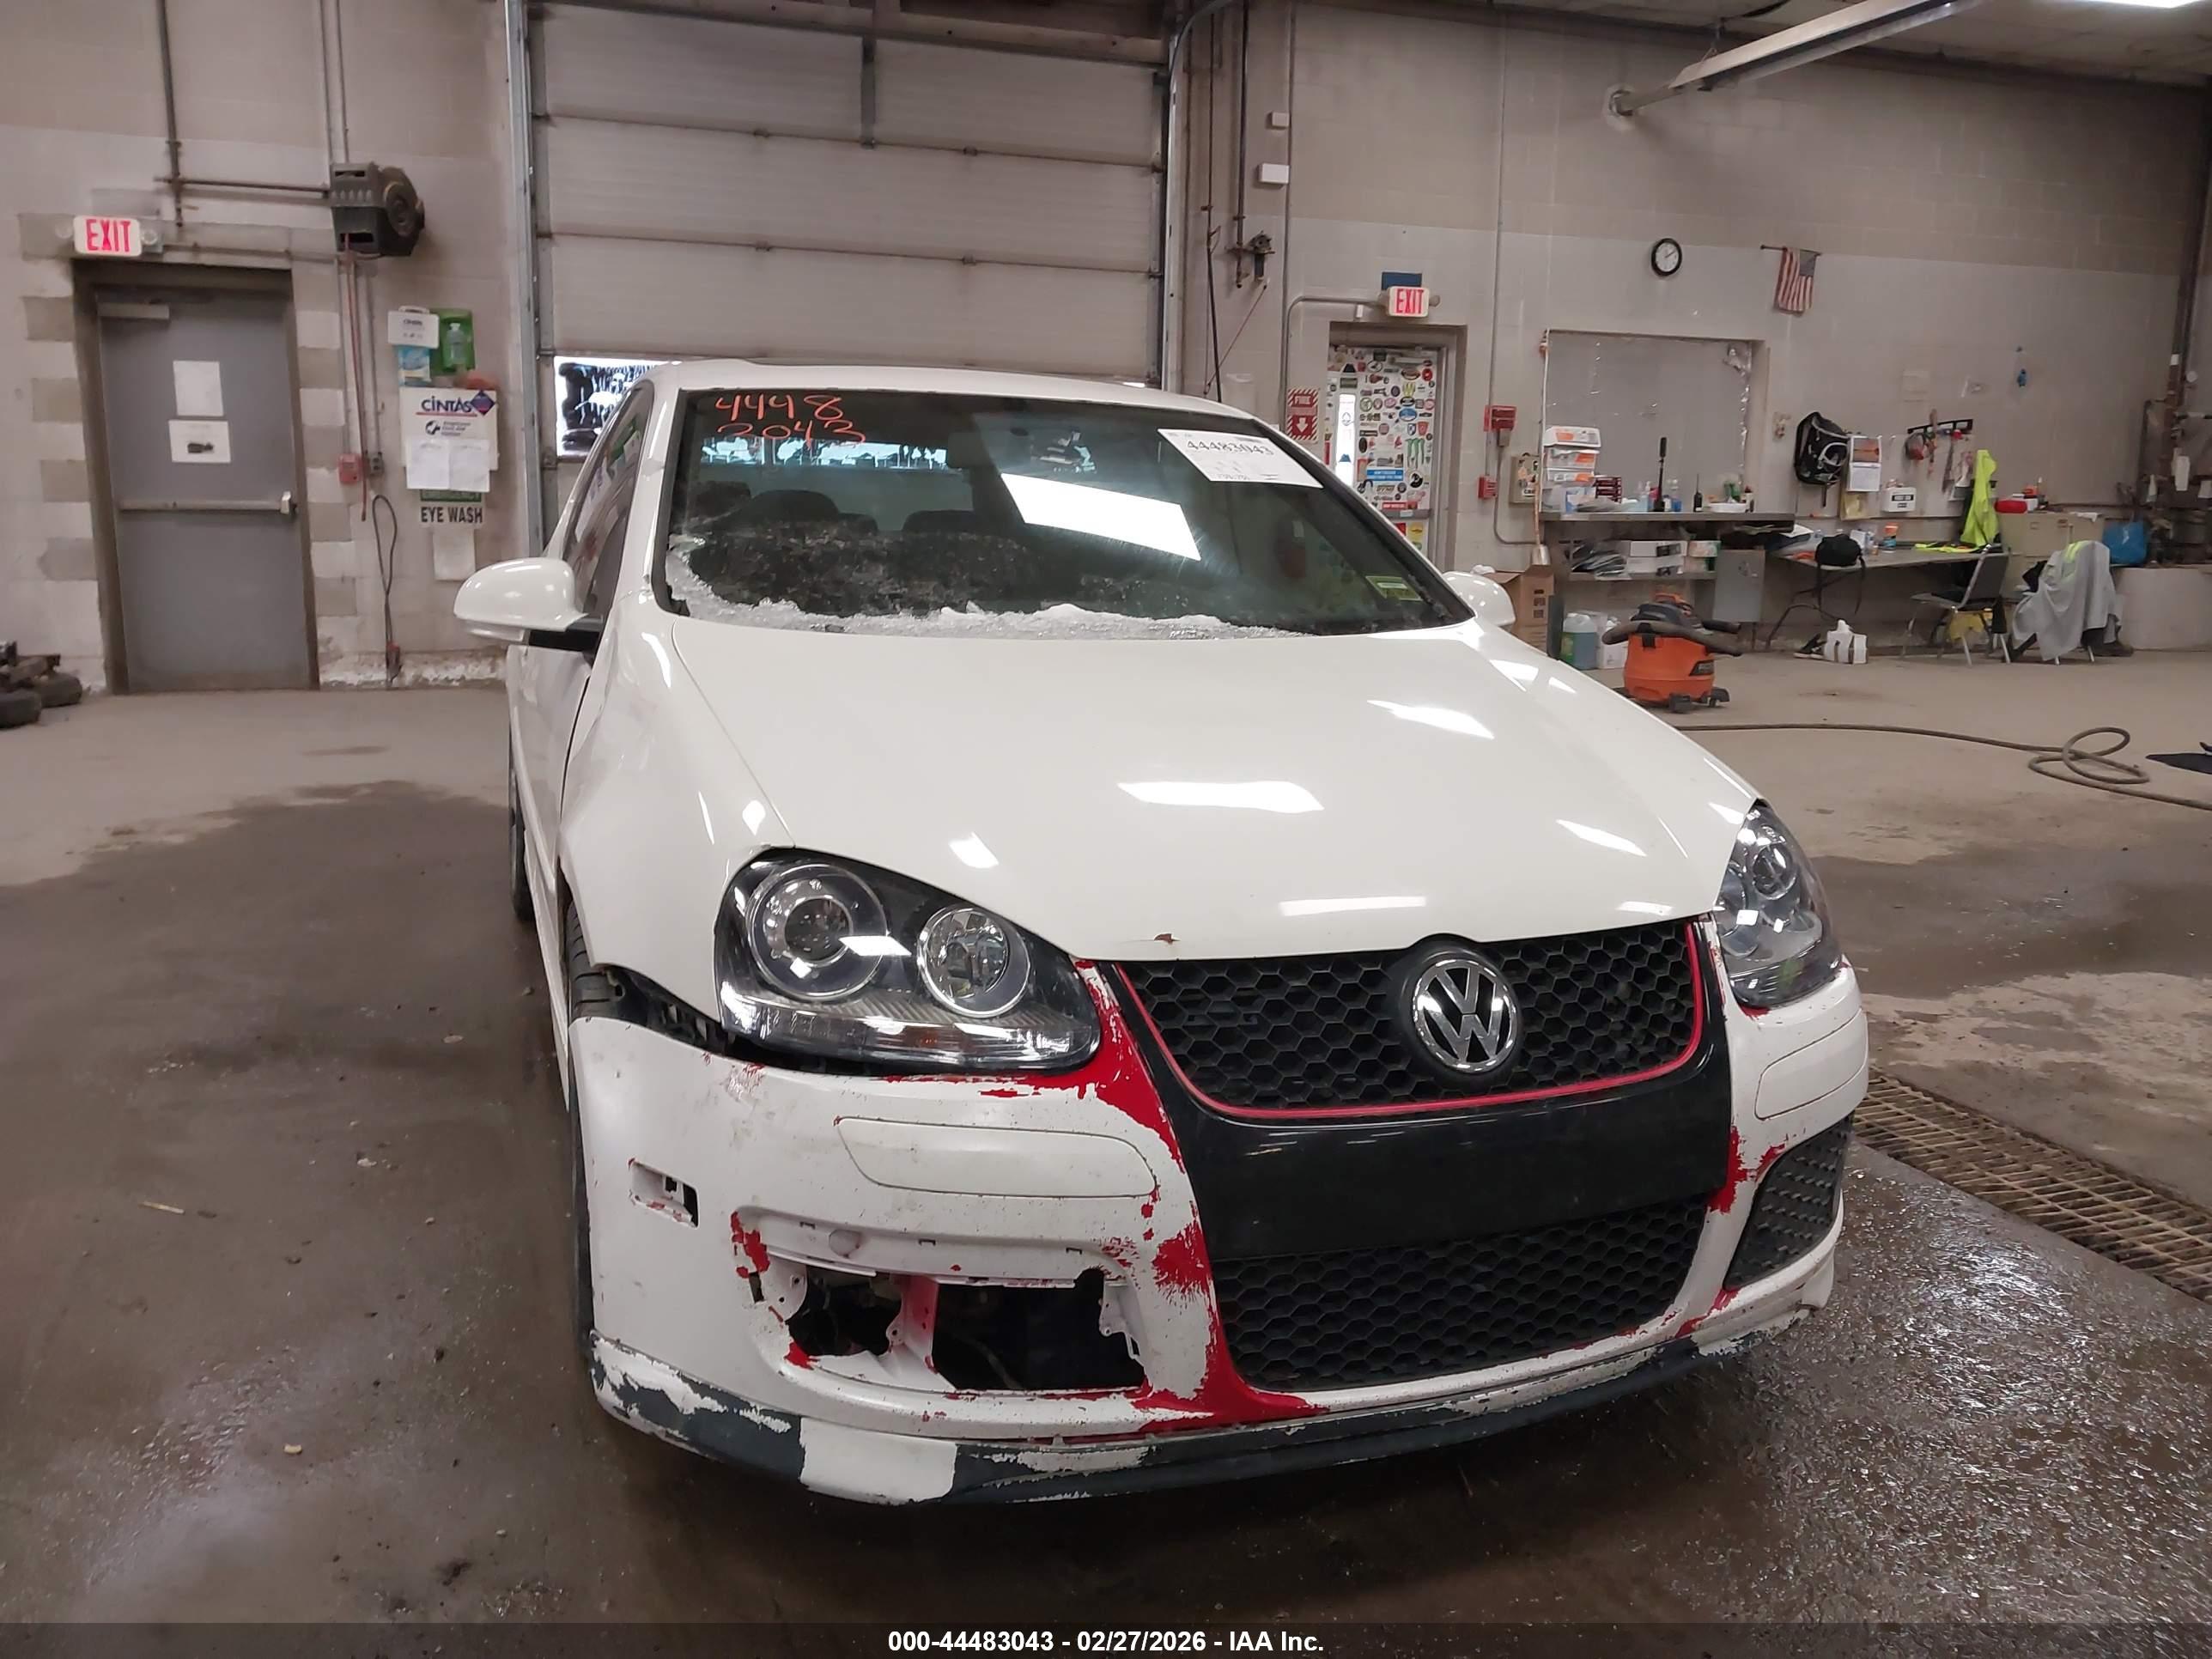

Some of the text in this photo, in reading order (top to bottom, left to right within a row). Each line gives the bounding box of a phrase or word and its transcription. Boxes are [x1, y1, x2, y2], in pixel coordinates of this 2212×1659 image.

[86, 219, 131, 252] EXIT
[1395, 288, 1424, 314] EXIT
[421, 396, 473, 413] CINTAS
[718, 420, 866, 450] 2043
[421, 507, 483, 523] EYE WASH
